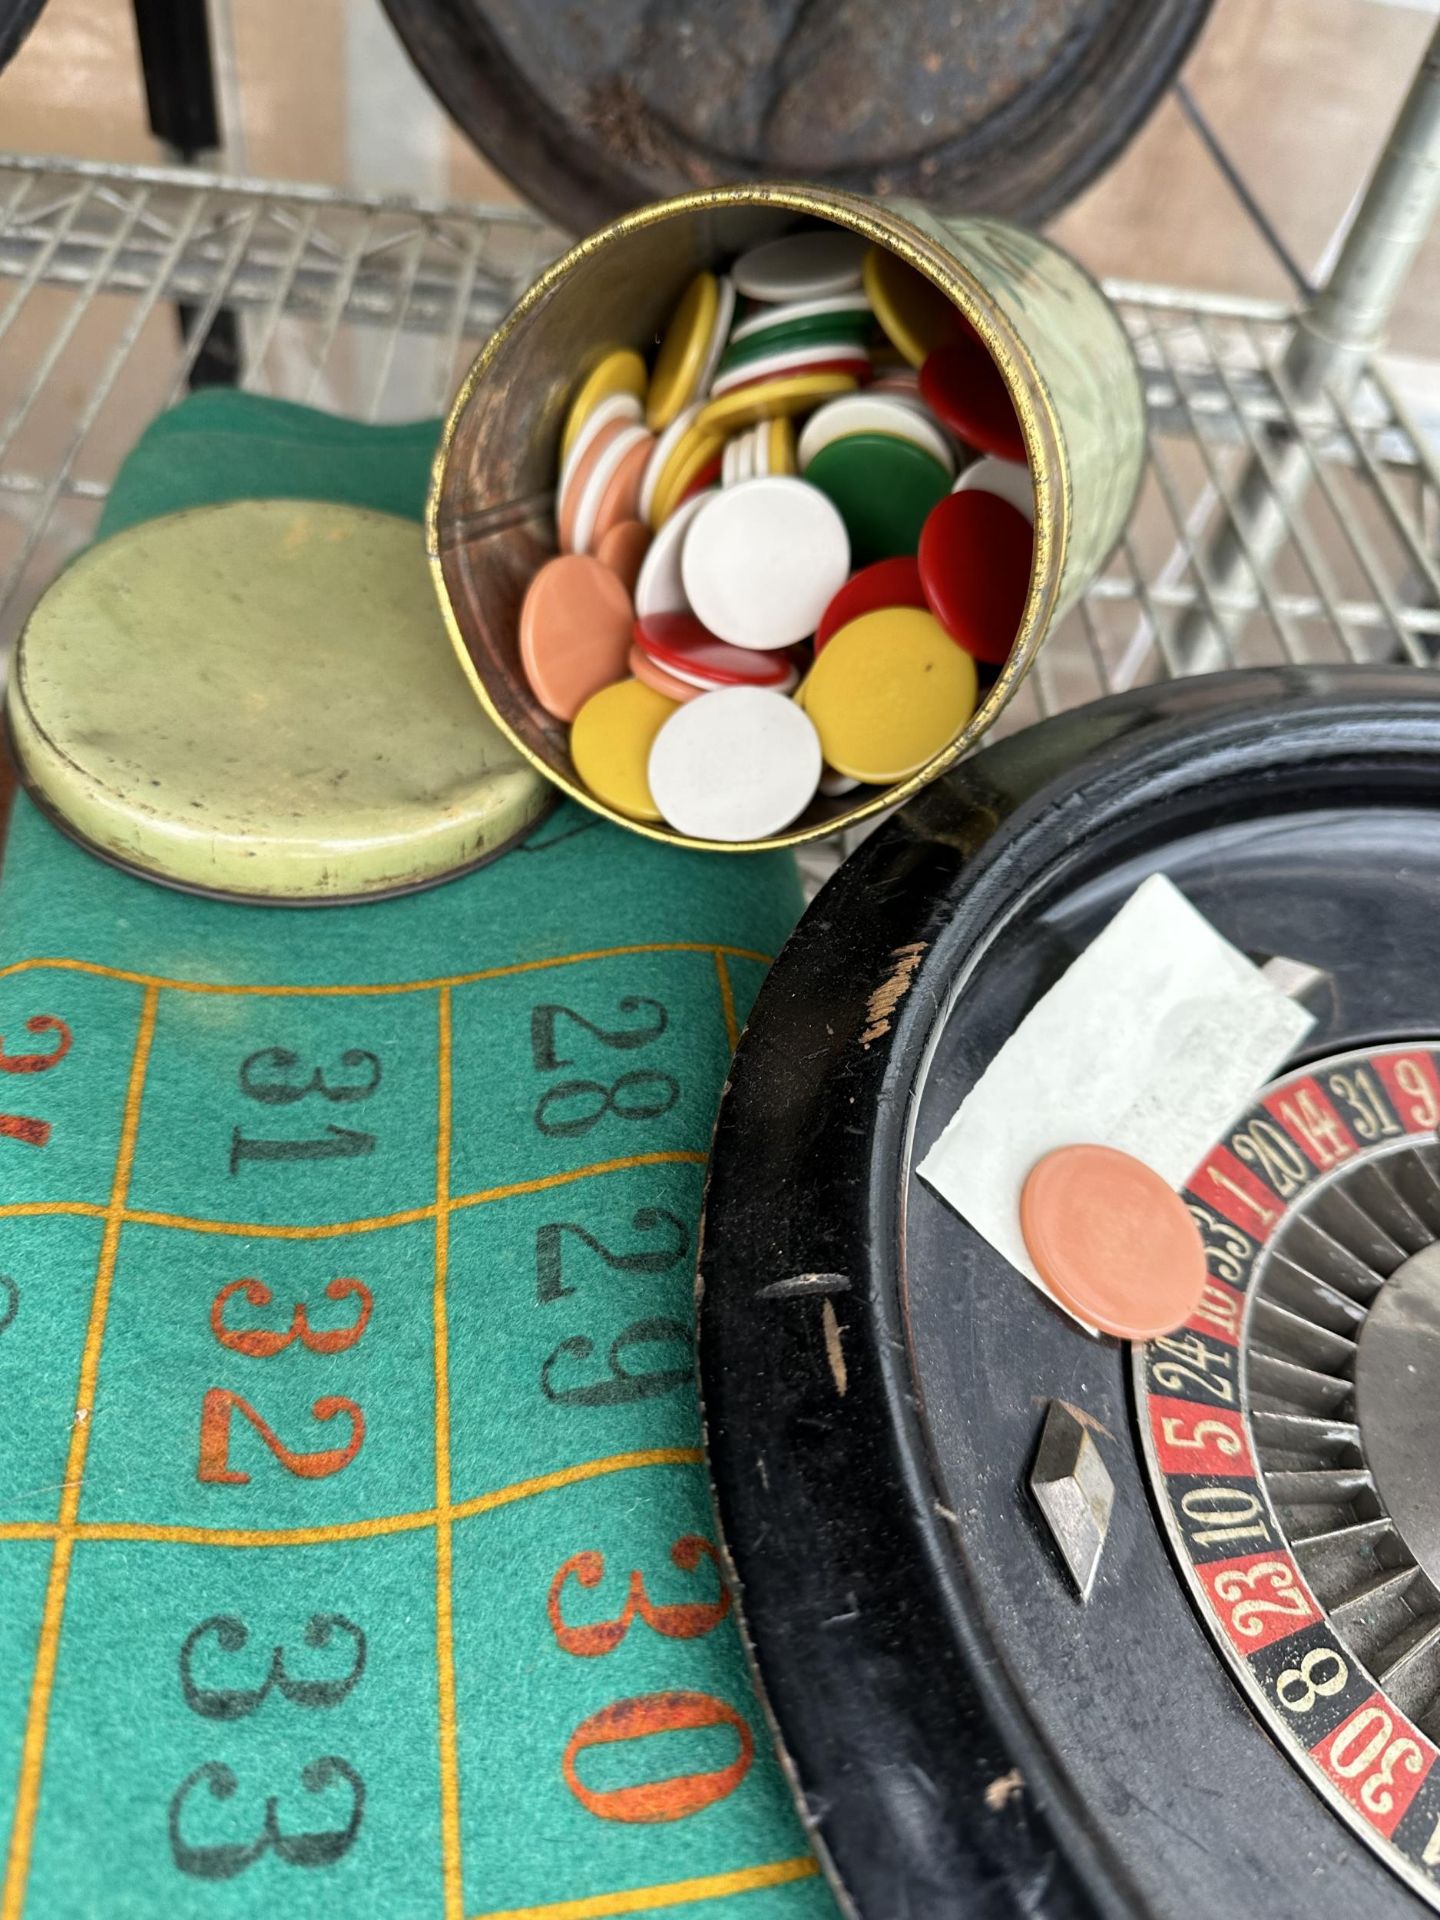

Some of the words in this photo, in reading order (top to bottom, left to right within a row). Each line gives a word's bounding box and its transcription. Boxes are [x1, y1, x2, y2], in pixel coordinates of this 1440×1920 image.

[531, 995, 680, 1138] 28
[1330, 1069, 1400, 1139] 31
[1393, 1058, 1438, 1128] 9
[229, 1046, 382, 1176] 31
[1280, 1088, 1350, 1165] 14
[1207, 1164, 1274, 1226] 1
[1233, 1119, 1309, 1195] 20
[536, 1207, 694, 1406] 29
[199, 1276, 374, 1485] 32
[1153, 1335, 1233, 1402] 24
[1161, 1415, 1243, 1456] 5
[1181, 1486, 1271, 1548] 10
[1214, 1560, 1313, 1637] 23
[547, 1535, 755, 1823] 30
[1276, 1647, 1349, 1713] 8
[167, 1613, 368, 1881] 33
[1330, 1706, 1424, 1814] 30
